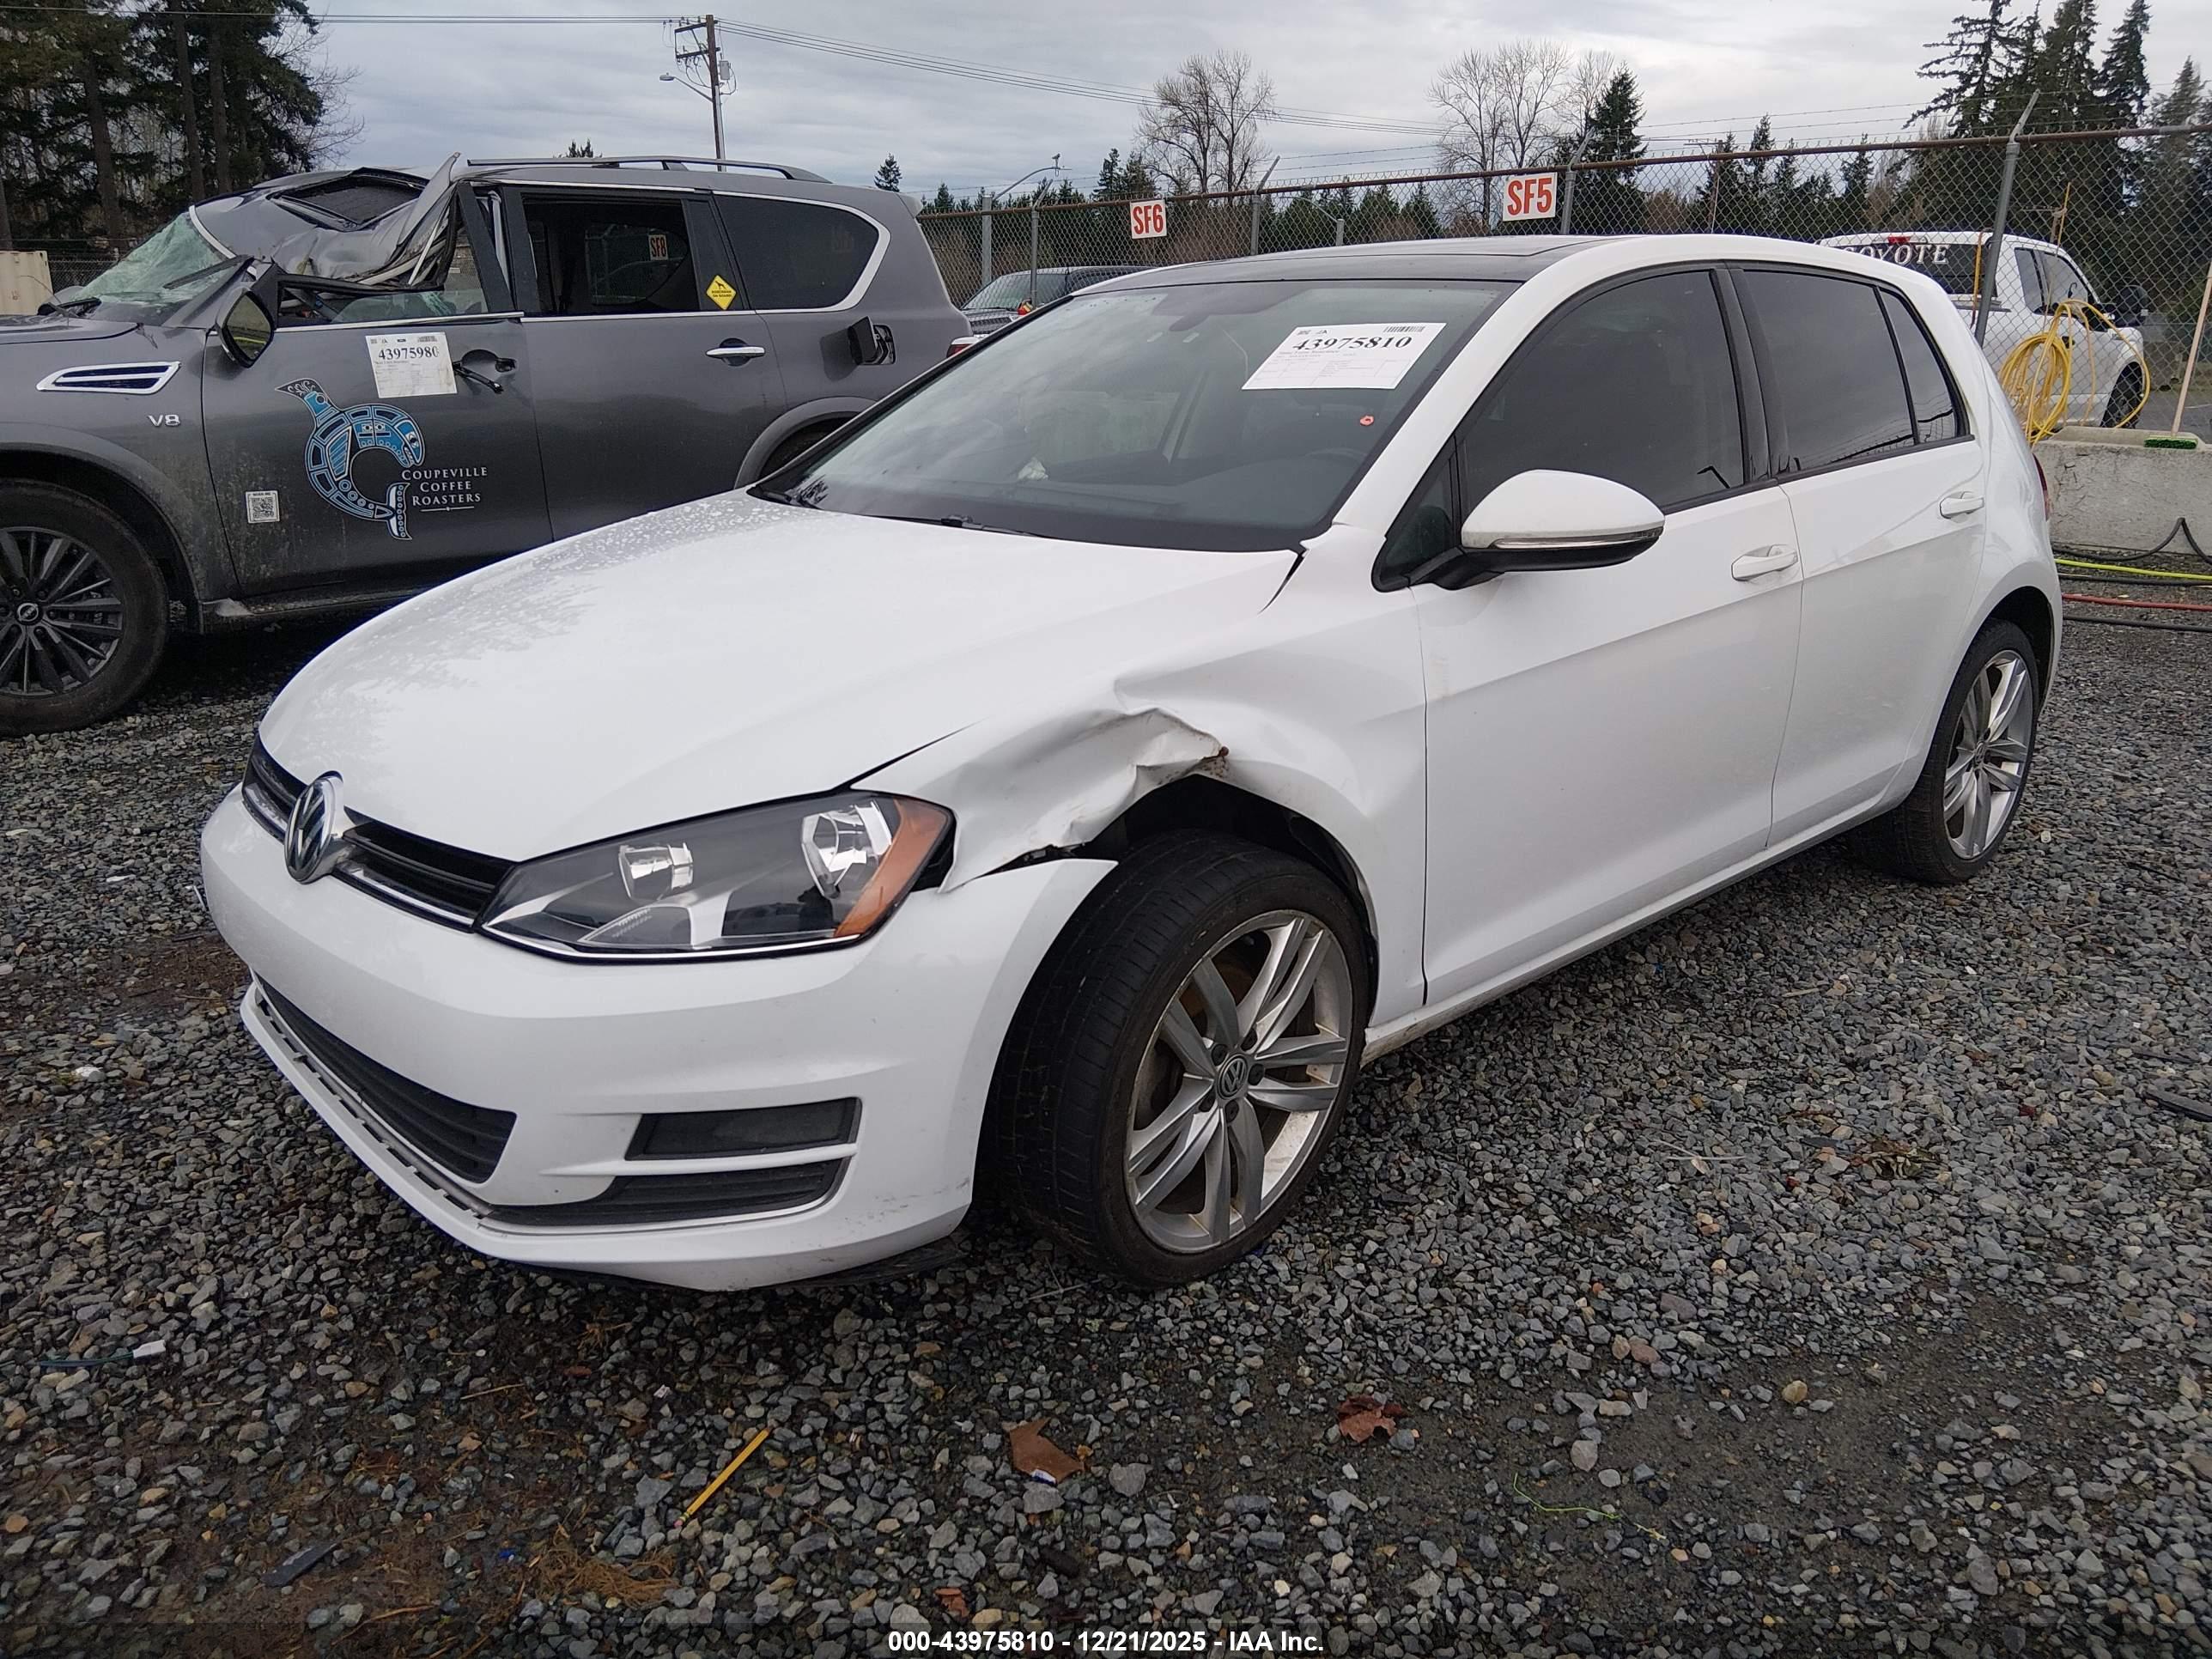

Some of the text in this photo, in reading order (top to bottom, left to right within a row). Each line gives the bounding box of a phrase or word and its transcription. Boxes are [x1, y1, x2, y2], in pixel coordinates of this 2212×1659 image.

[1506, 176, 1553, 216] SF5
[1133, 205, 1164, 234] SF6
[650, 236, 666, 258] SF8
[1844, 244, 1951, 265] OYOTE
[1292, 336, 1413, 350] 43975810
[378, 345, 440, 360] 43975980
[148, 414, 181, 427] V8
[401, 466, 488, 481] COUPEVILLE
[420, 480, 471, 493] COFFEE
[412, 493, 481, 507] ROASTERS
